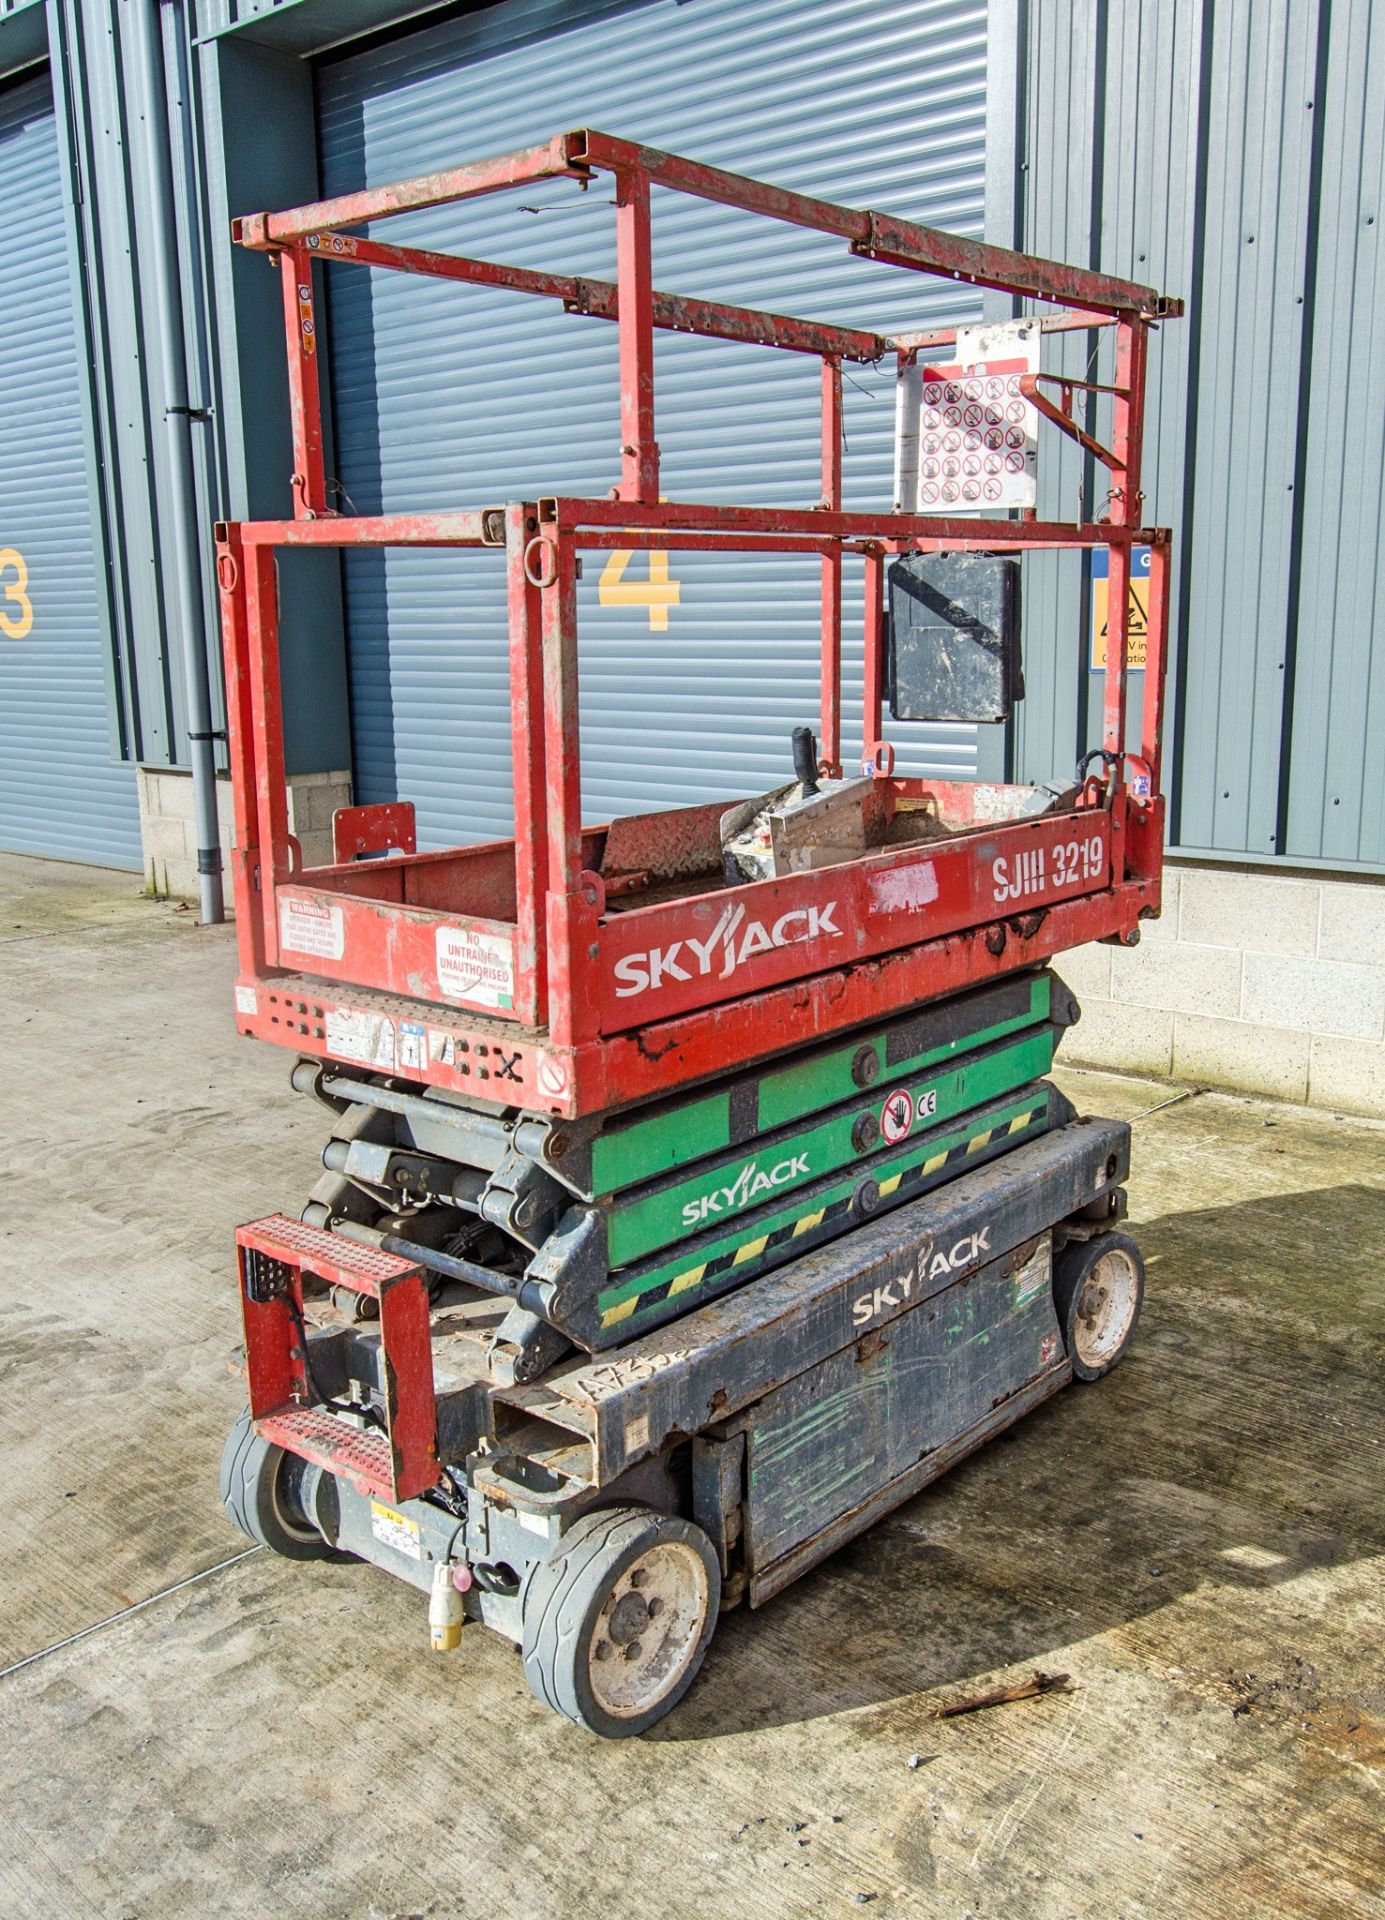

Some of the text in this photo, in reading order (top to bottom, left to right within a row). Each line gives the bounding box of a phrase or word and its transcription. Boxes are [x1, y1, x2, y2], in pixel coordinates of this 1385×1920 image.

[0, 547, 33, 639] 3
[599, 497, 680, 631] 4
[1052, 836, 1103, 888] 3219
[291, 902, 329, 919] WARNING
[466, 931, 480, 946] NO
[440, 957, 509, 983] UNAUTHORISED
[614, 901, 844, 998] SKYJACK
[682, 1152, 811, 1226] SKYJACK
